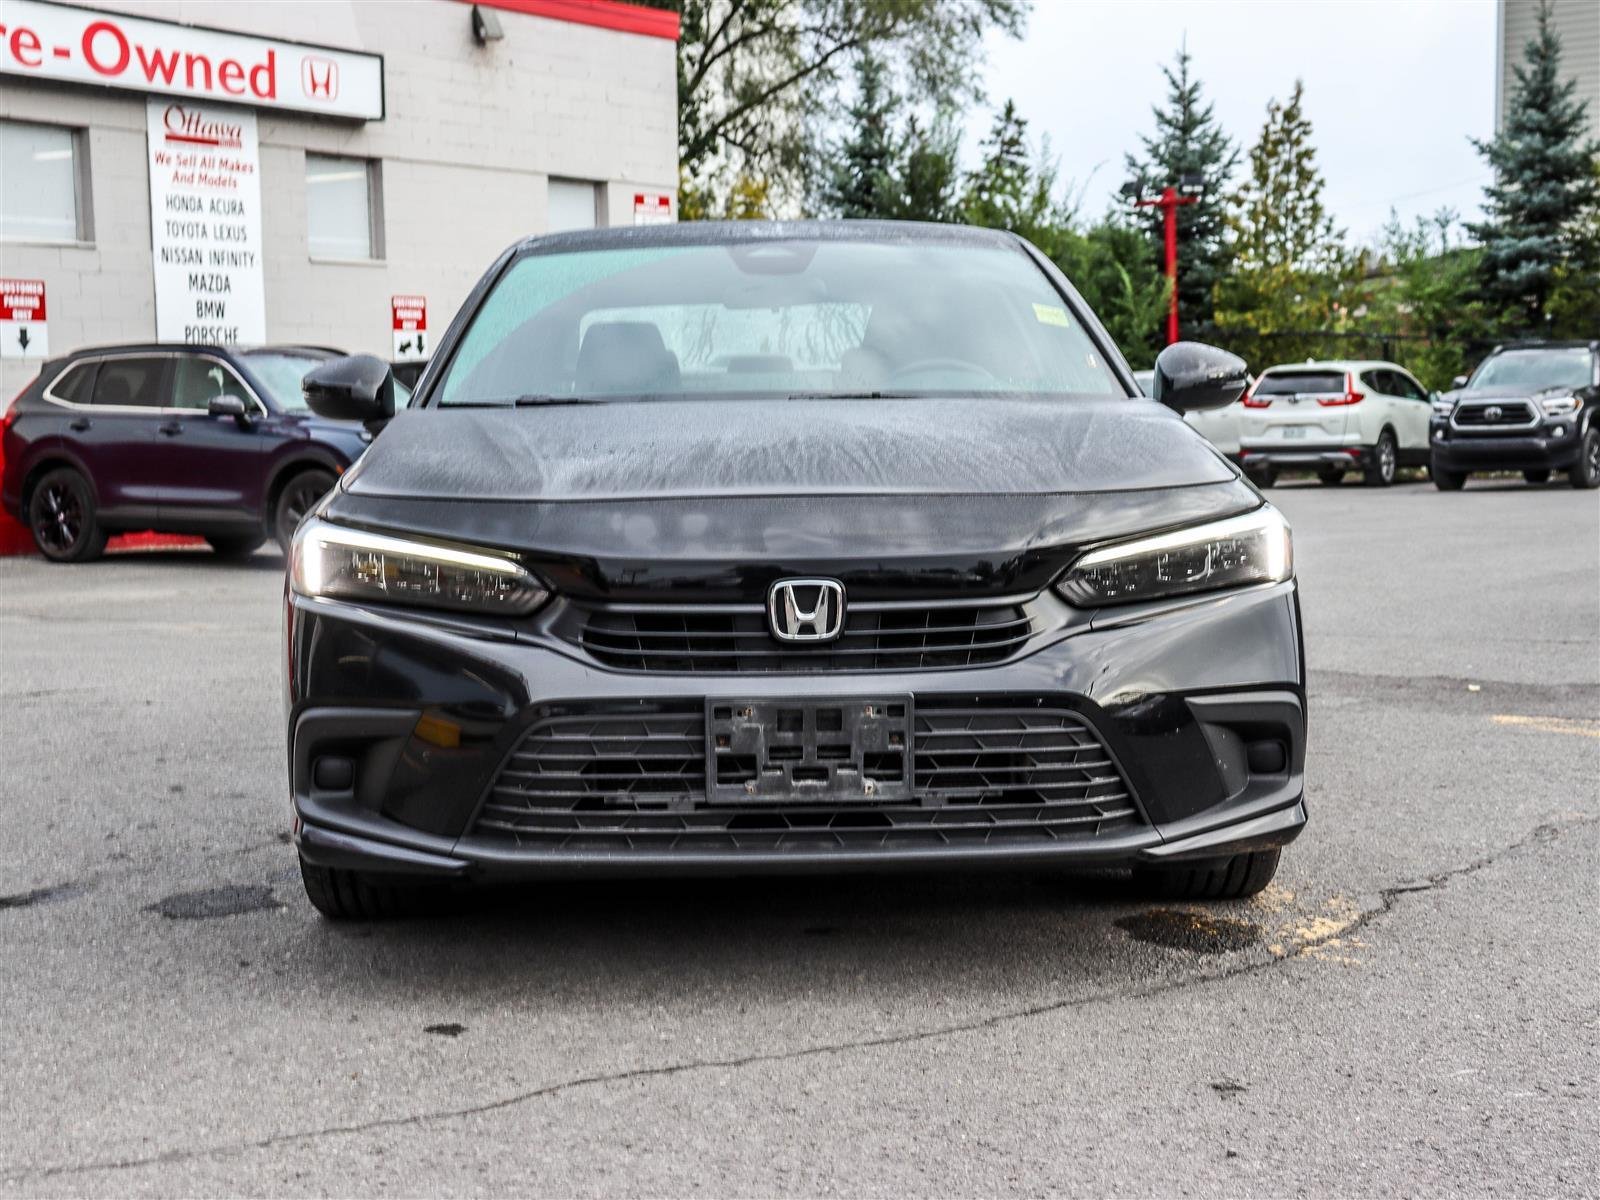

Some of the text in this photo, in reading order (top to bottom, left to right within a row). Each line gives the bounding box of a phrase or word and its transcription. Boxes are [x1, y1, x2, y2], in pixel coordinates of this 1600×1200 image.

[0, 22, 277, 99] e-Owned
[163, 104, 242, 137] Ottawa
[155, 150, 253, 173] We Sell All Makes
[172, 170, 237, 188] And Models
[165, 194, 244, 216] HONDA ACURA
[166, 220, 247, 242] TOYOTA LEXUS
[161, 247, 255, 268] NISSAN INFINITY
[188, 273, 231, 294] MAZDA
[196, 299, 225, 319] BMW
[184, 325, 239, 345] PORSCHE
